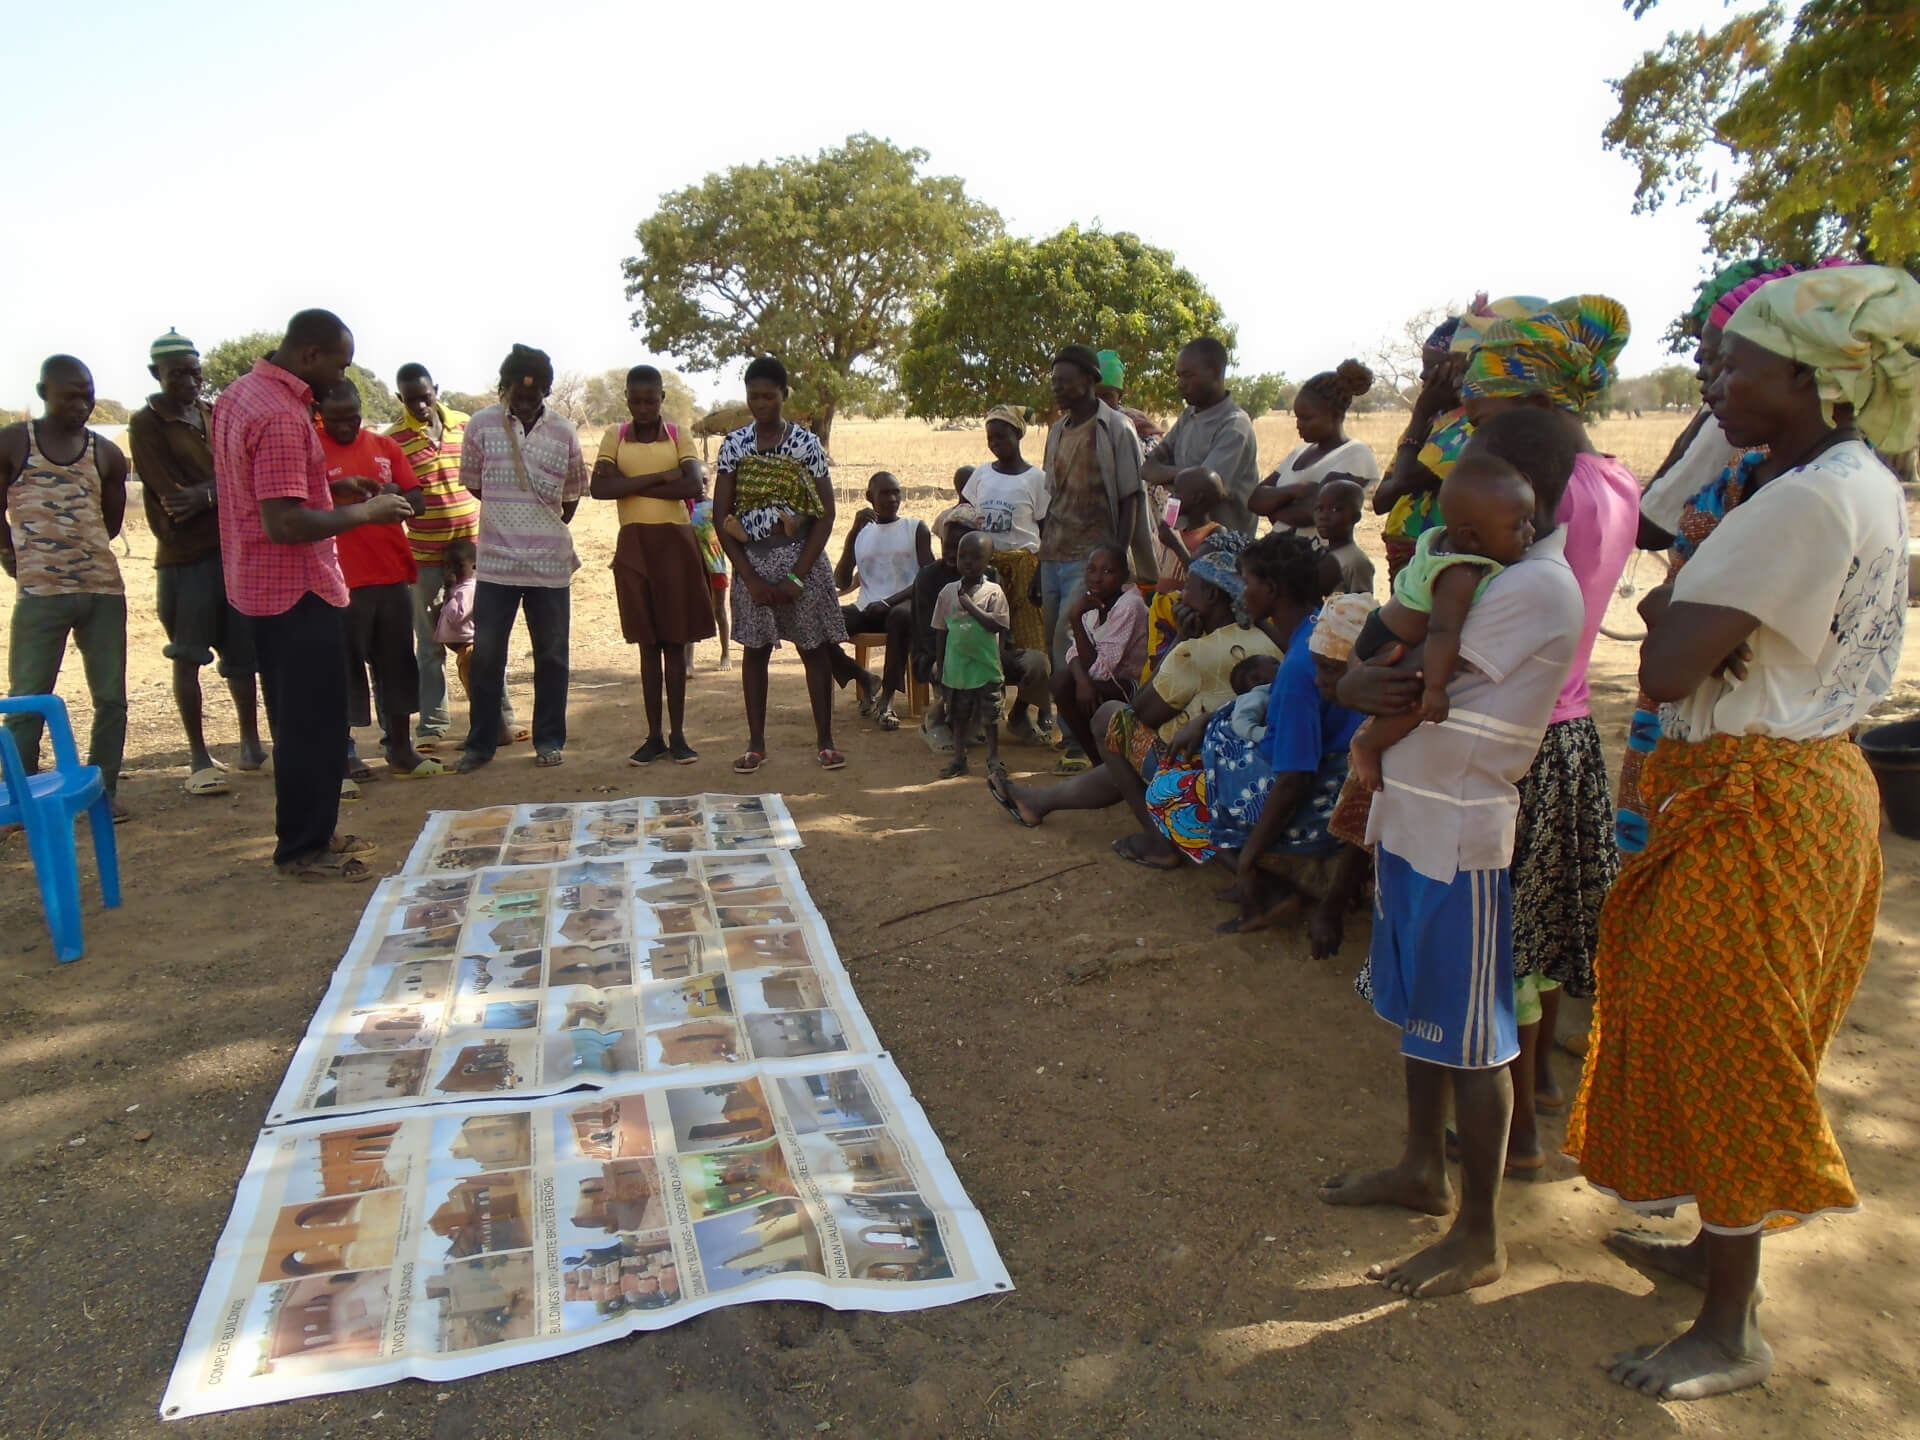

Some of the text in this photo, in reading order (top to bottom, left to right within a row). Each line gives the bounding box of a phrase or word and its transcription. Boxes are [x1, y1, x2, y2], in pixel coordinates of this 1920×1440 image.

[832, 1244, 847, 1278] NUBIAN
[549, 1290, 561, 1334] BUILDINGS
[208, 1298, 245, 1385] COMPLEX BUILDINGS
